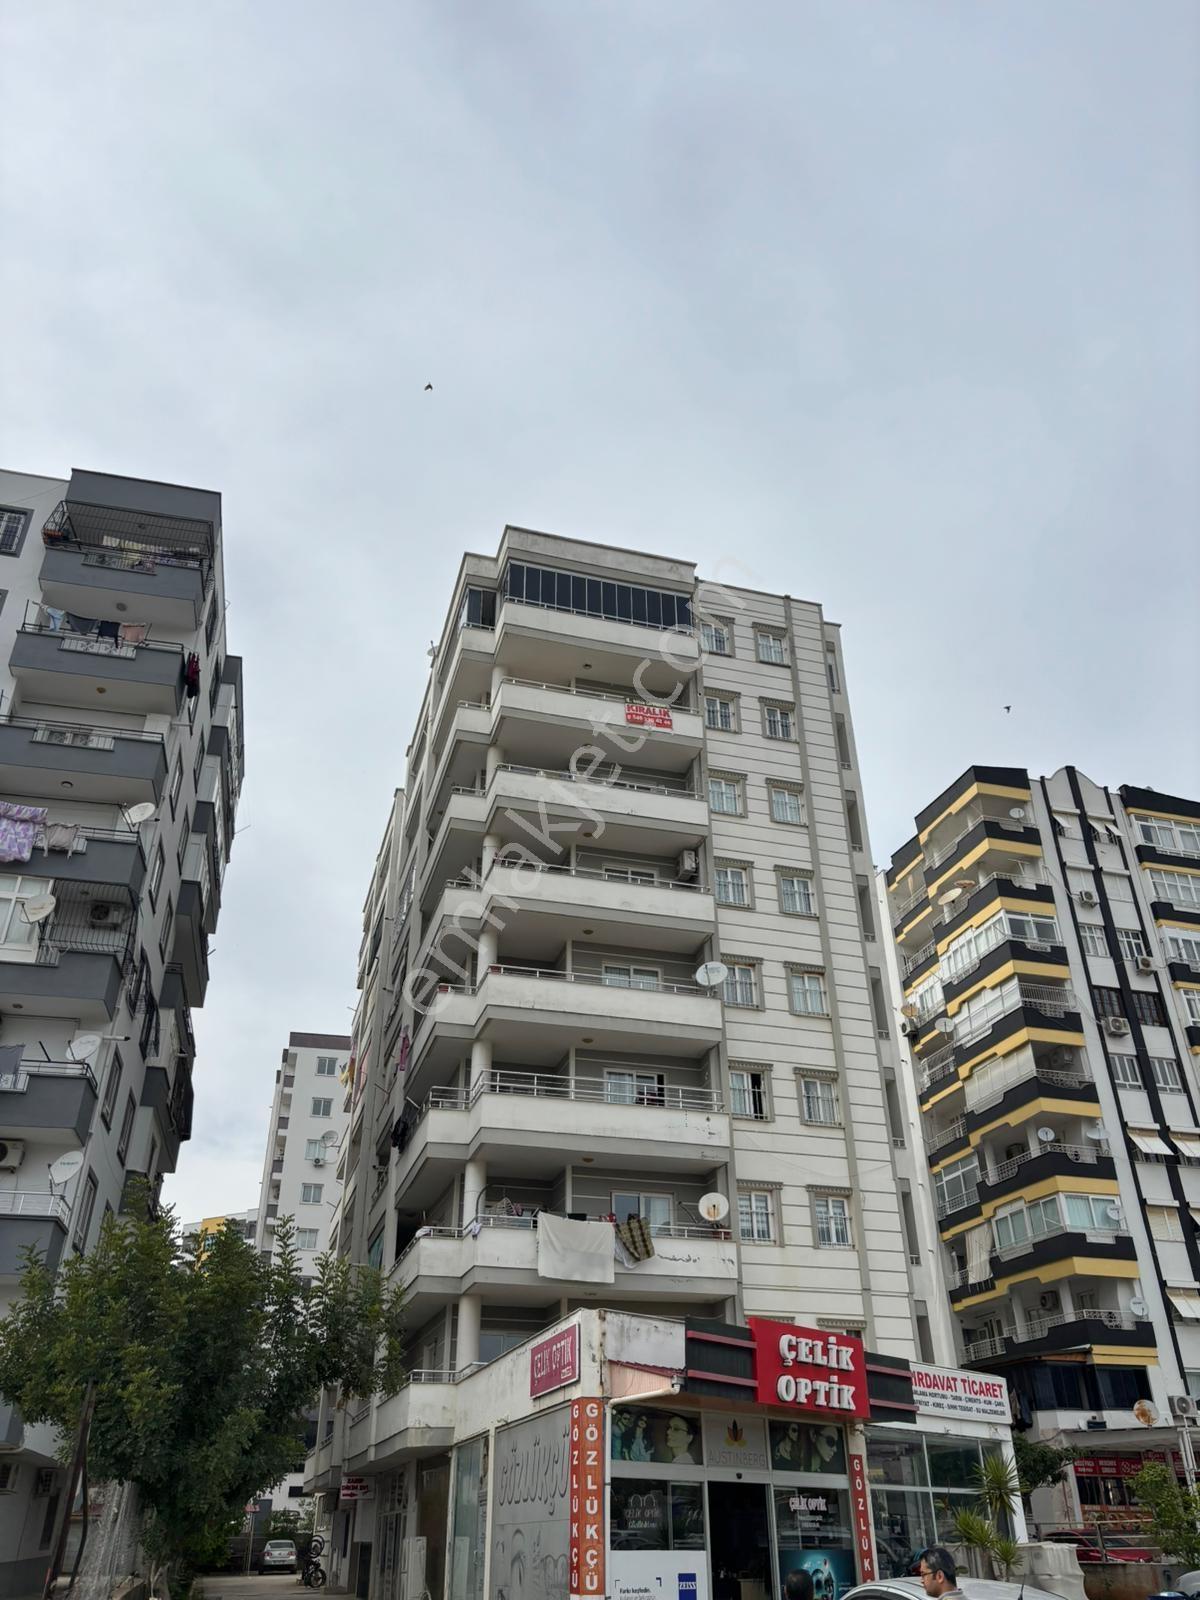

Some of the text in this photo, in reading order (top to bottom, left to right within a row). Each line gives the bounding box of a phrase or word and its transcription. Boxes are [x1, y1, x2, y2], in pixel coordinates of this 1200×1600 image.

[626, 704, 671, 718] KIRALIK
[779, 1333, 855, 1371] ÇELİK
[777, 1375, 856, 1410] OPTİK
[912, 1371, 1003, 1399] IRDAVAT TİCARET
[707, 1449, 766, 1466] AUSTINBERG
[571, 1404, 579, 1588] GÖZLÜKÇÜ
[585, 1403, 598, 1591] GÖZLÜKÇÜ
[853, 1459, 872, 1583] GÖZLÜK
